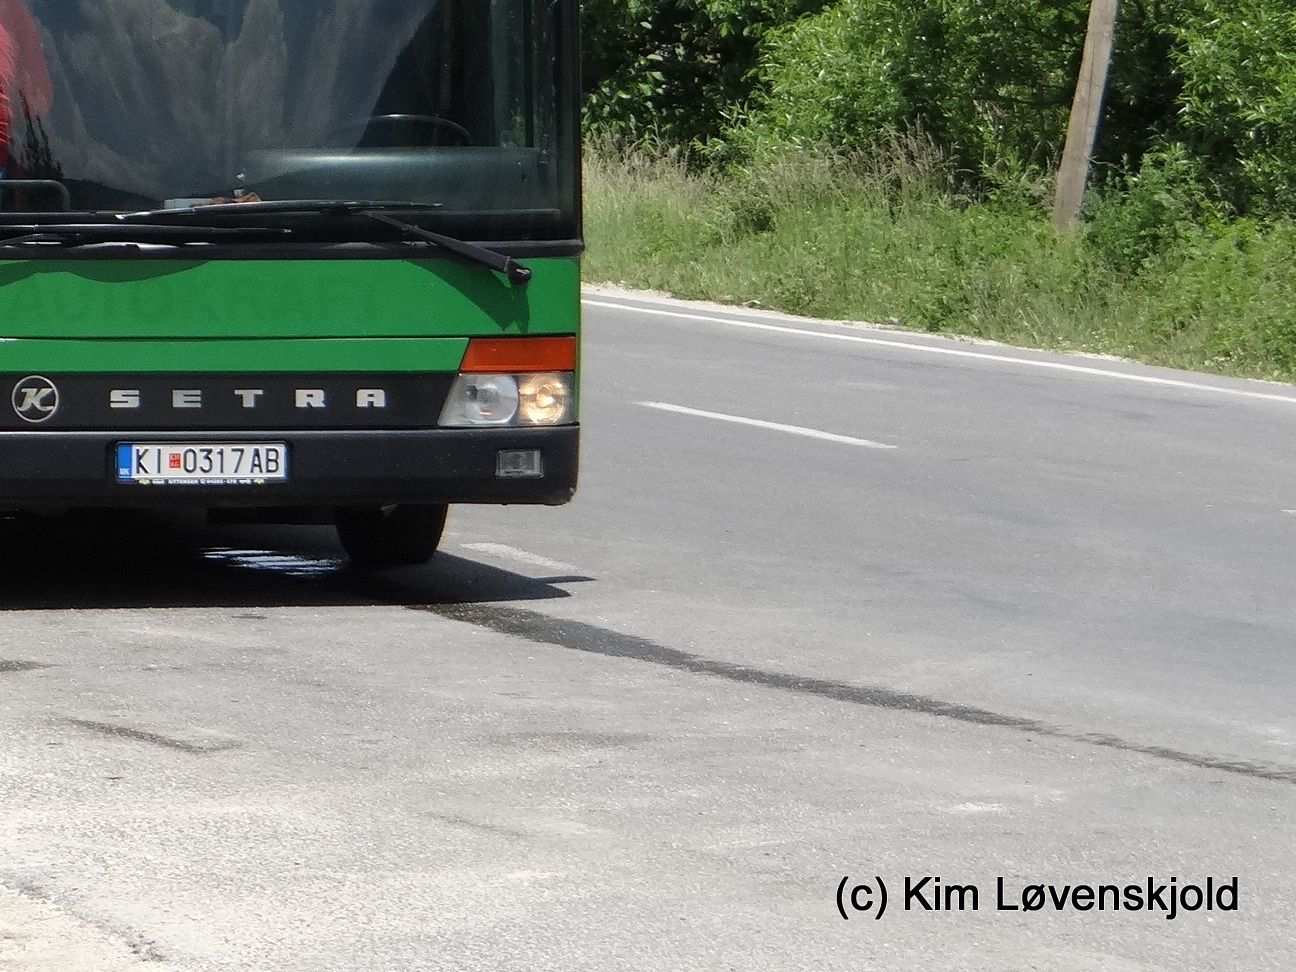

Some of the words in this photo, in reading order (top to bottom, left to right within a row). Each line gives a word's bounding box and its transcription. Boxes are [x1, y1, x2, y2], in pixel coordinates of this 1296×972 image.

[109, 389, 386, 408] SETRA
[135, 448, 162, 474] KI
[183, 448, 280, 474] 0317AB
[119, 467, 130, 475] MK
